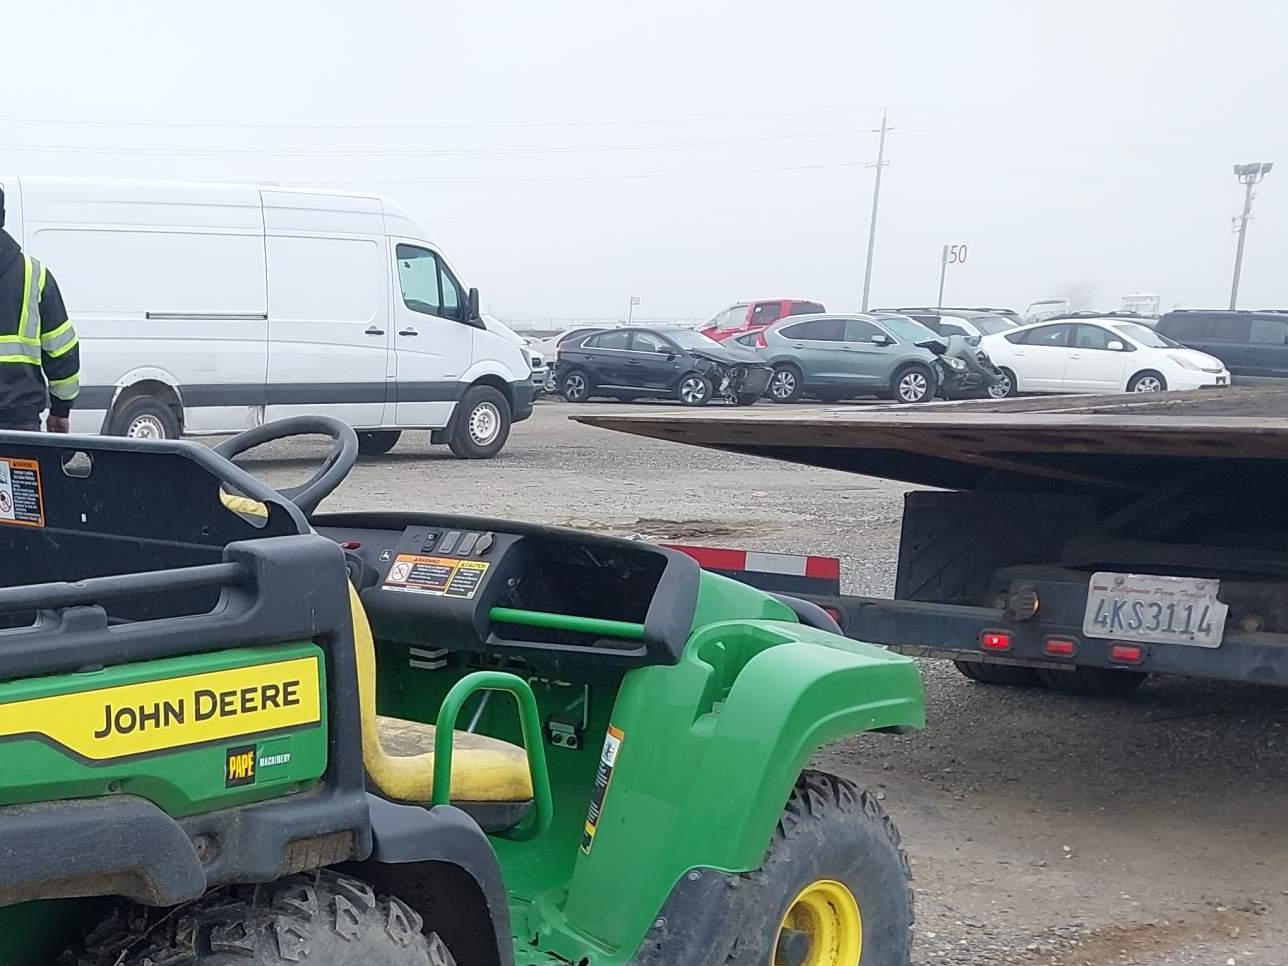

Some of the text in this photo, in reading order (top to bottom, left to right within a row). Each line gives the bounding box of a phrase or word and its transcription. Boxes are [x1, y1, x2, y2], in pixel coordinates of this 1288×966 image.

[948, 244, 967, 264] 50
[1093, 598, 1213, 637] 4KS3114
[93, 680, 301, 739] JOHN DEERE
